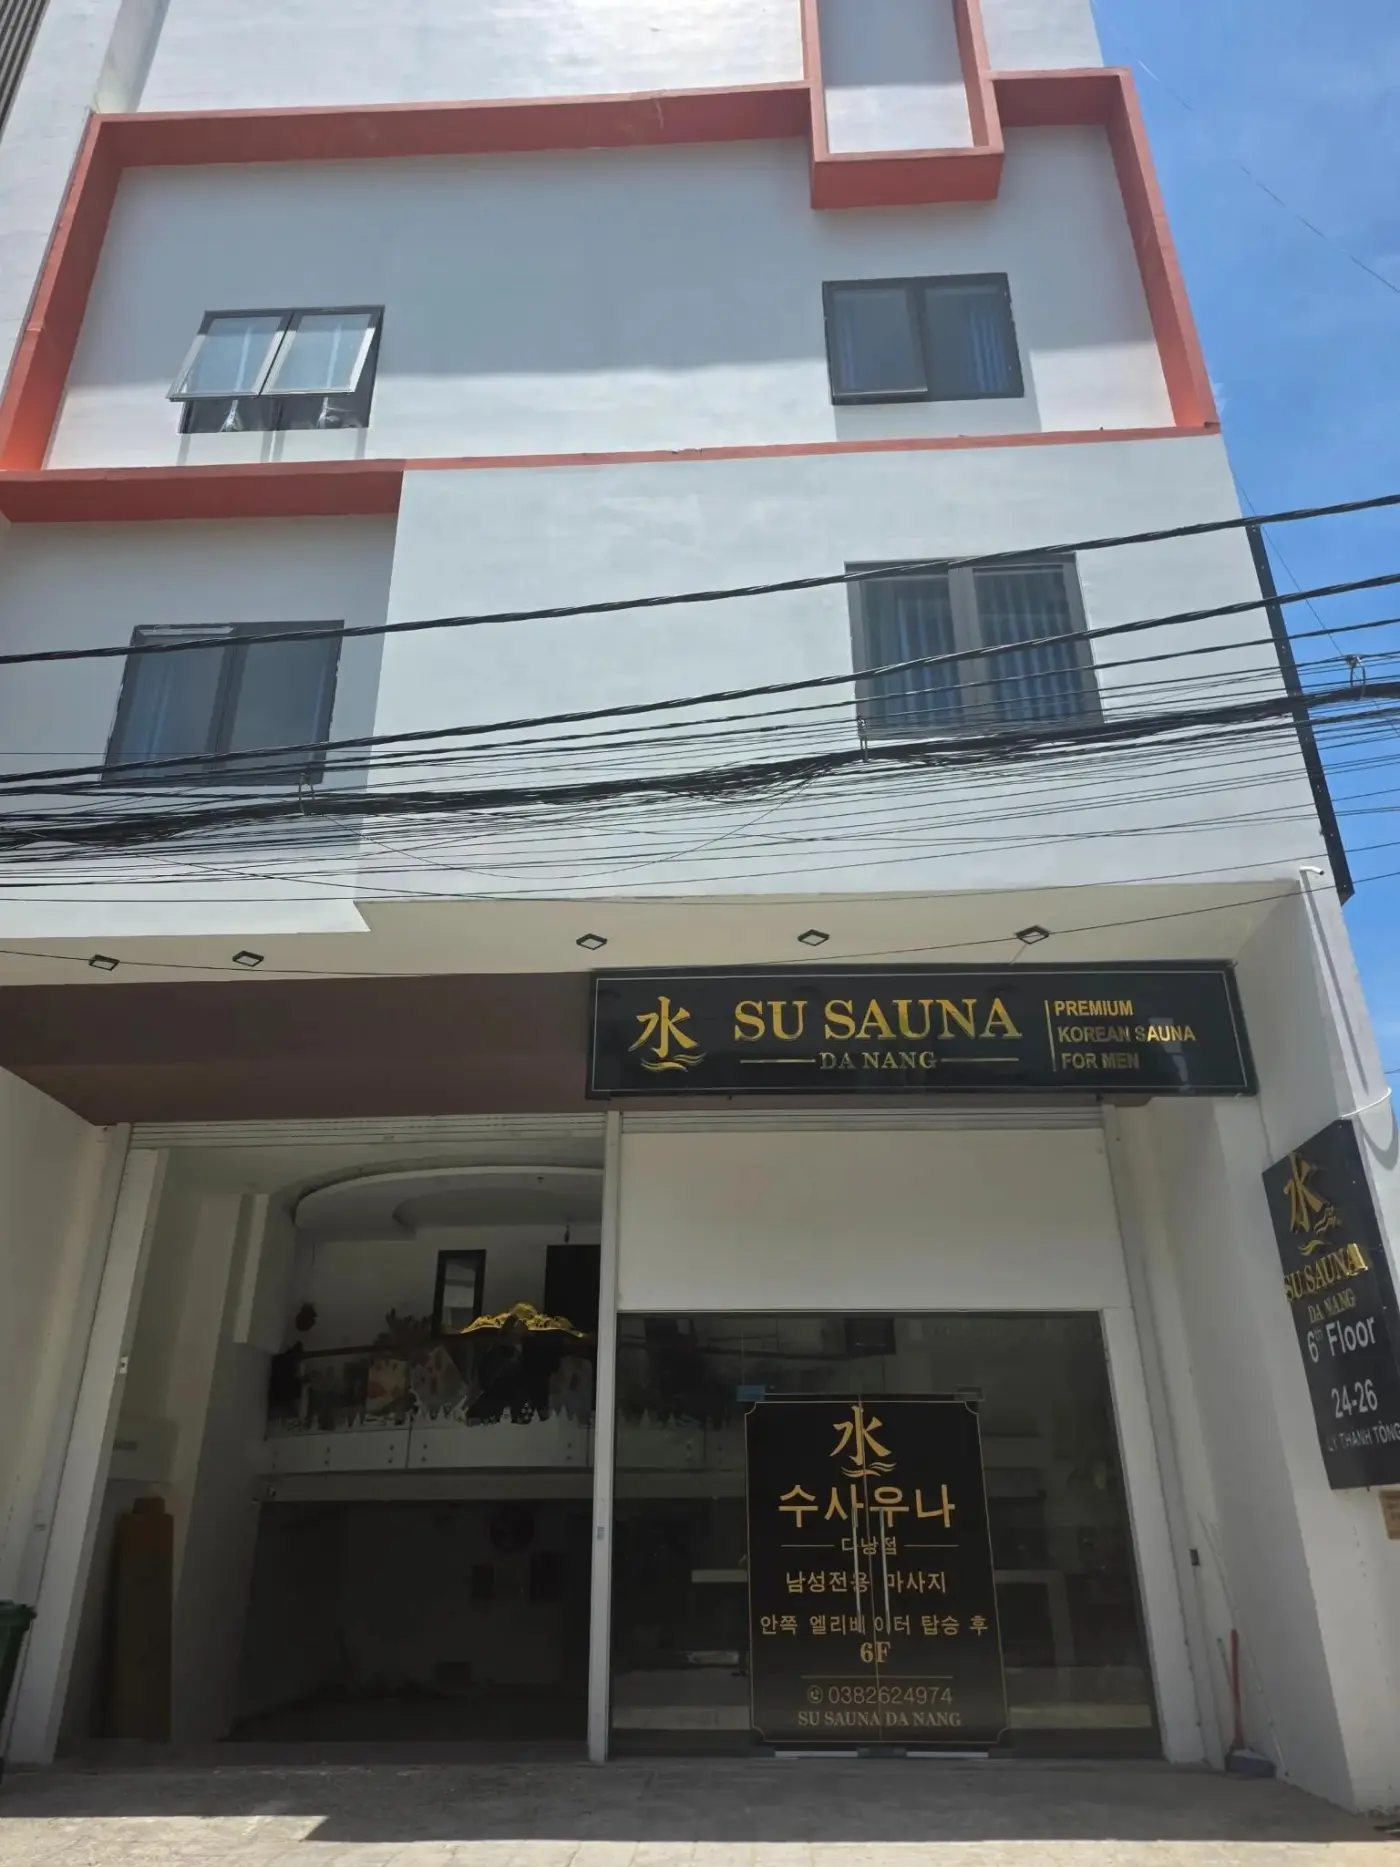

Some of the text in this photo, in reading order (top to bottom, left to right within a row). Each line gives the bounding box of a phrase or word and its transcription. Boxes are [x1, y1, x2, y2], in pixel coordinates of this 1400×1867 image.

[1054, 1000, 1134, 1016] PREMIUM
[628, 996, 701, 1058] 水
[733, 998, 1023, 1042] SU SAUNA
[1058, 1025, 1196, 1043] KOREAN SAUNA
[819, 1051, 937, 1069] DA NANG
[1061, 1053, 1140, 1070] FOR MEN
[1284, 1243, 1368, 1303] SU SAUNA
[1308, 1288, 1357, 1324] DA NANG
[1325, 1316, 1376, 1357] Floor
[1331, 1379, 1378, 1418] 24-26
[829, 1405, 892, 1466] 水
[778, 1484, 956, 1528] 수사우나
[786, 1571, 946, 1594] 남성전용 마사지
[760, 1615, 798, 1635] 안쪽
[922, 1615, 960, 1636] 탑승
[969, 1615, 988, 1636] 후
[860, 1641, 891, 1663] 6F
[828, 1686, 952, 1704] 0382624974
[798, 1711, 962, 1727] SU SAUNA DA NANG
